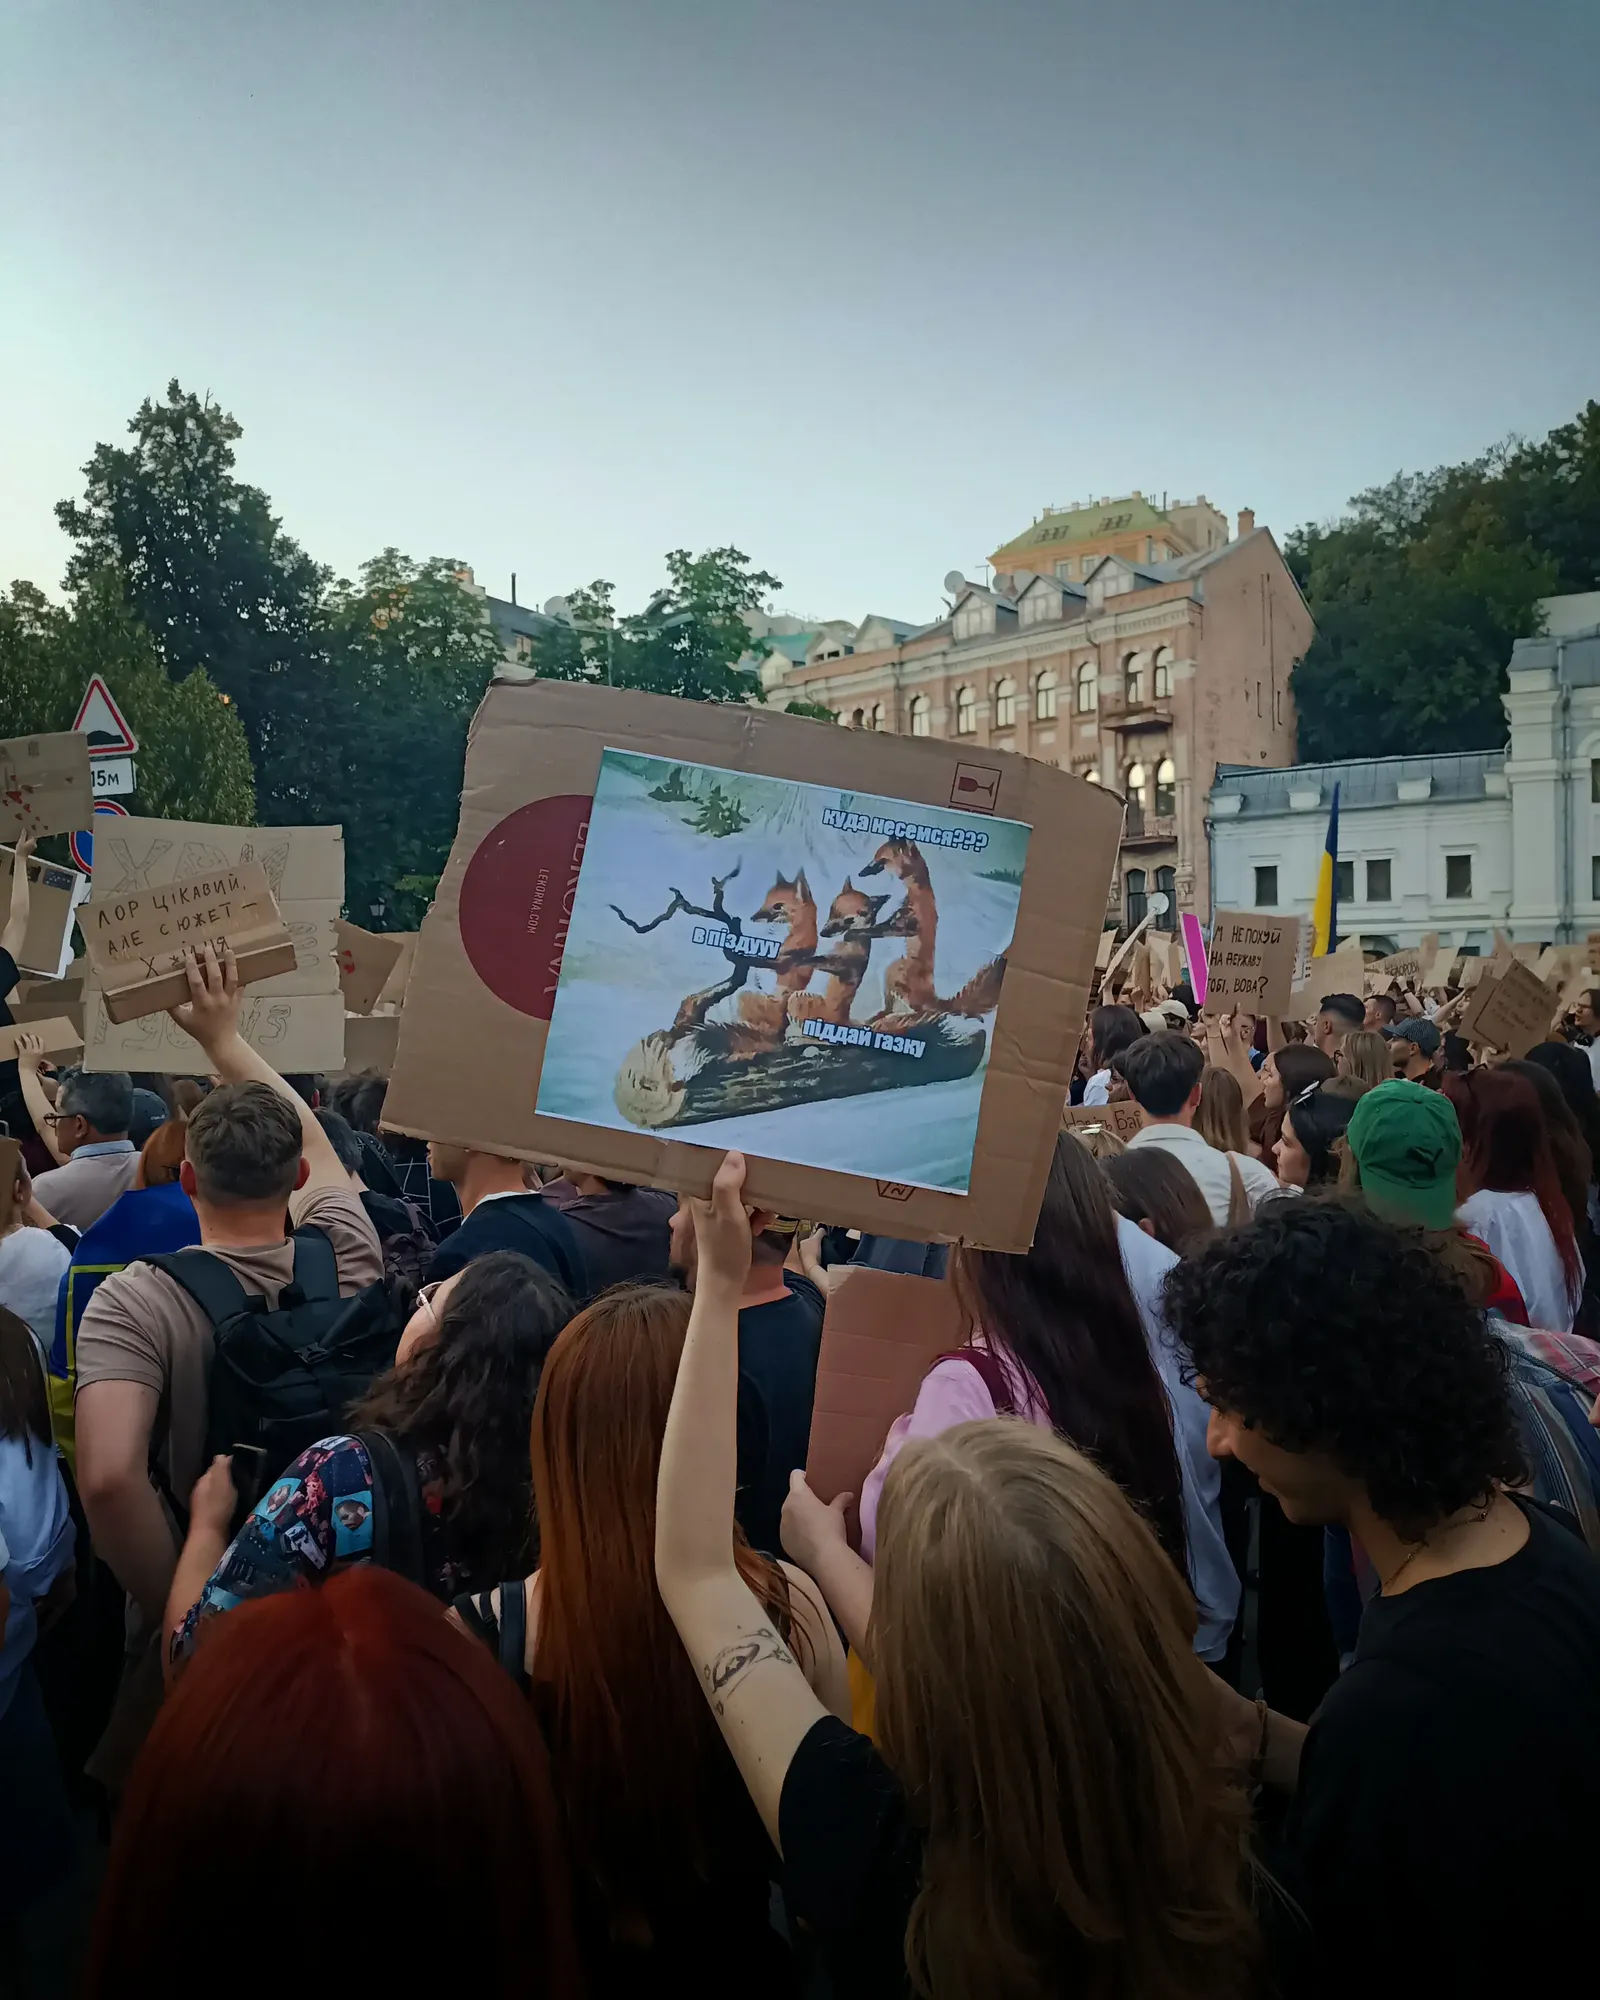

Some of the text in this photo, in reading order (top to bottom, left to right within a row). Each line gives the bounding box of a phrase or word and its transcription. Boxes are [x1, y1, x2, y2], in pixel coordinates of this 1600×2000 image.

[822, 808, 990, 852] куда несемся???
[99, 901, 140, 929] ЛОР
[526, 868, 549, 934] LEKORNA.COM
[108, 930, 144, 955] АЛЕ
[692, 926, 707, 944] в
[1233, 975, 1269, 999] ВОВА?
[802, 1017, 927, 1059] піддай газку
